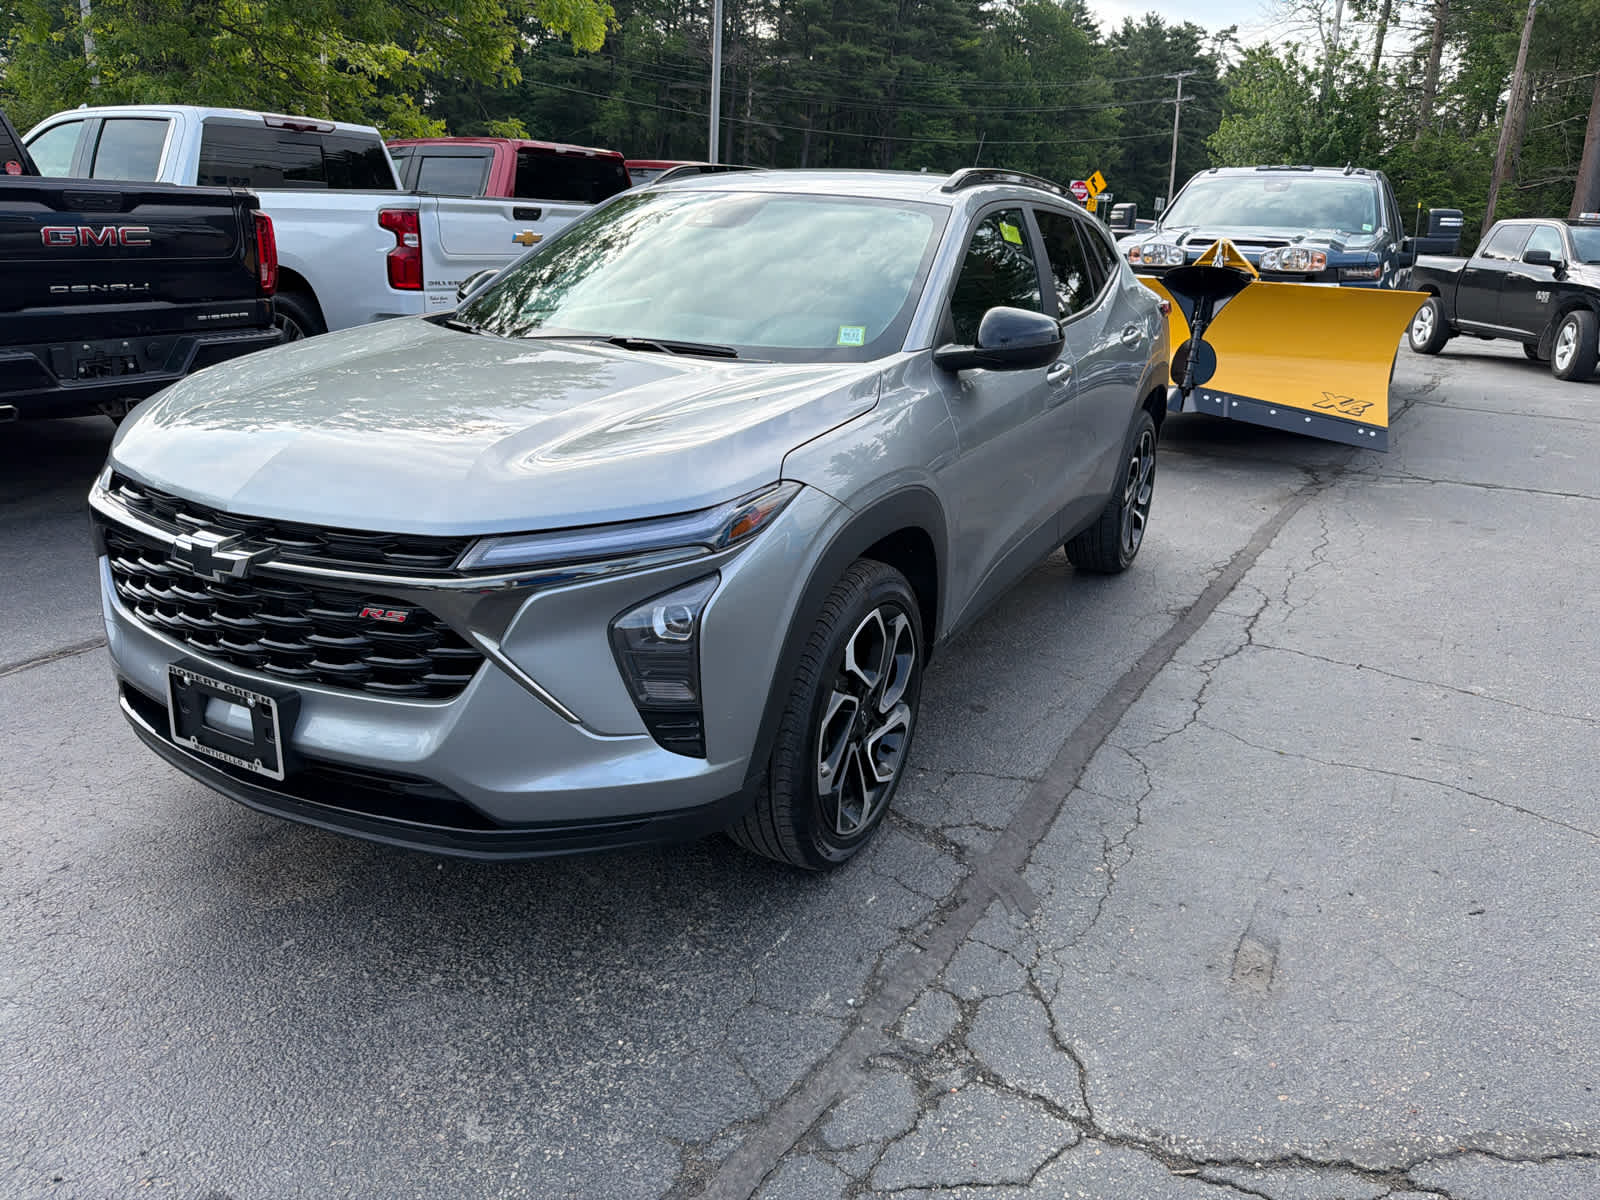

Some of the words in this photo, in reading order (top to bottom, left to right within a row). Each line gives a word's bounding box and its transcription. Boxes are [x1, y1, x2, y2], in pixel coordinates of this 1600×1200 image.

[40, 226, 151, 246] GMC
[49, 282, 150, 293] DENALI
[197, 311, 249, 321] SIERRA
[358, 607, 409, 623] RS
[168, 666, 219, 688] ROBERT
[223, 685, 271, 704] GREEN
